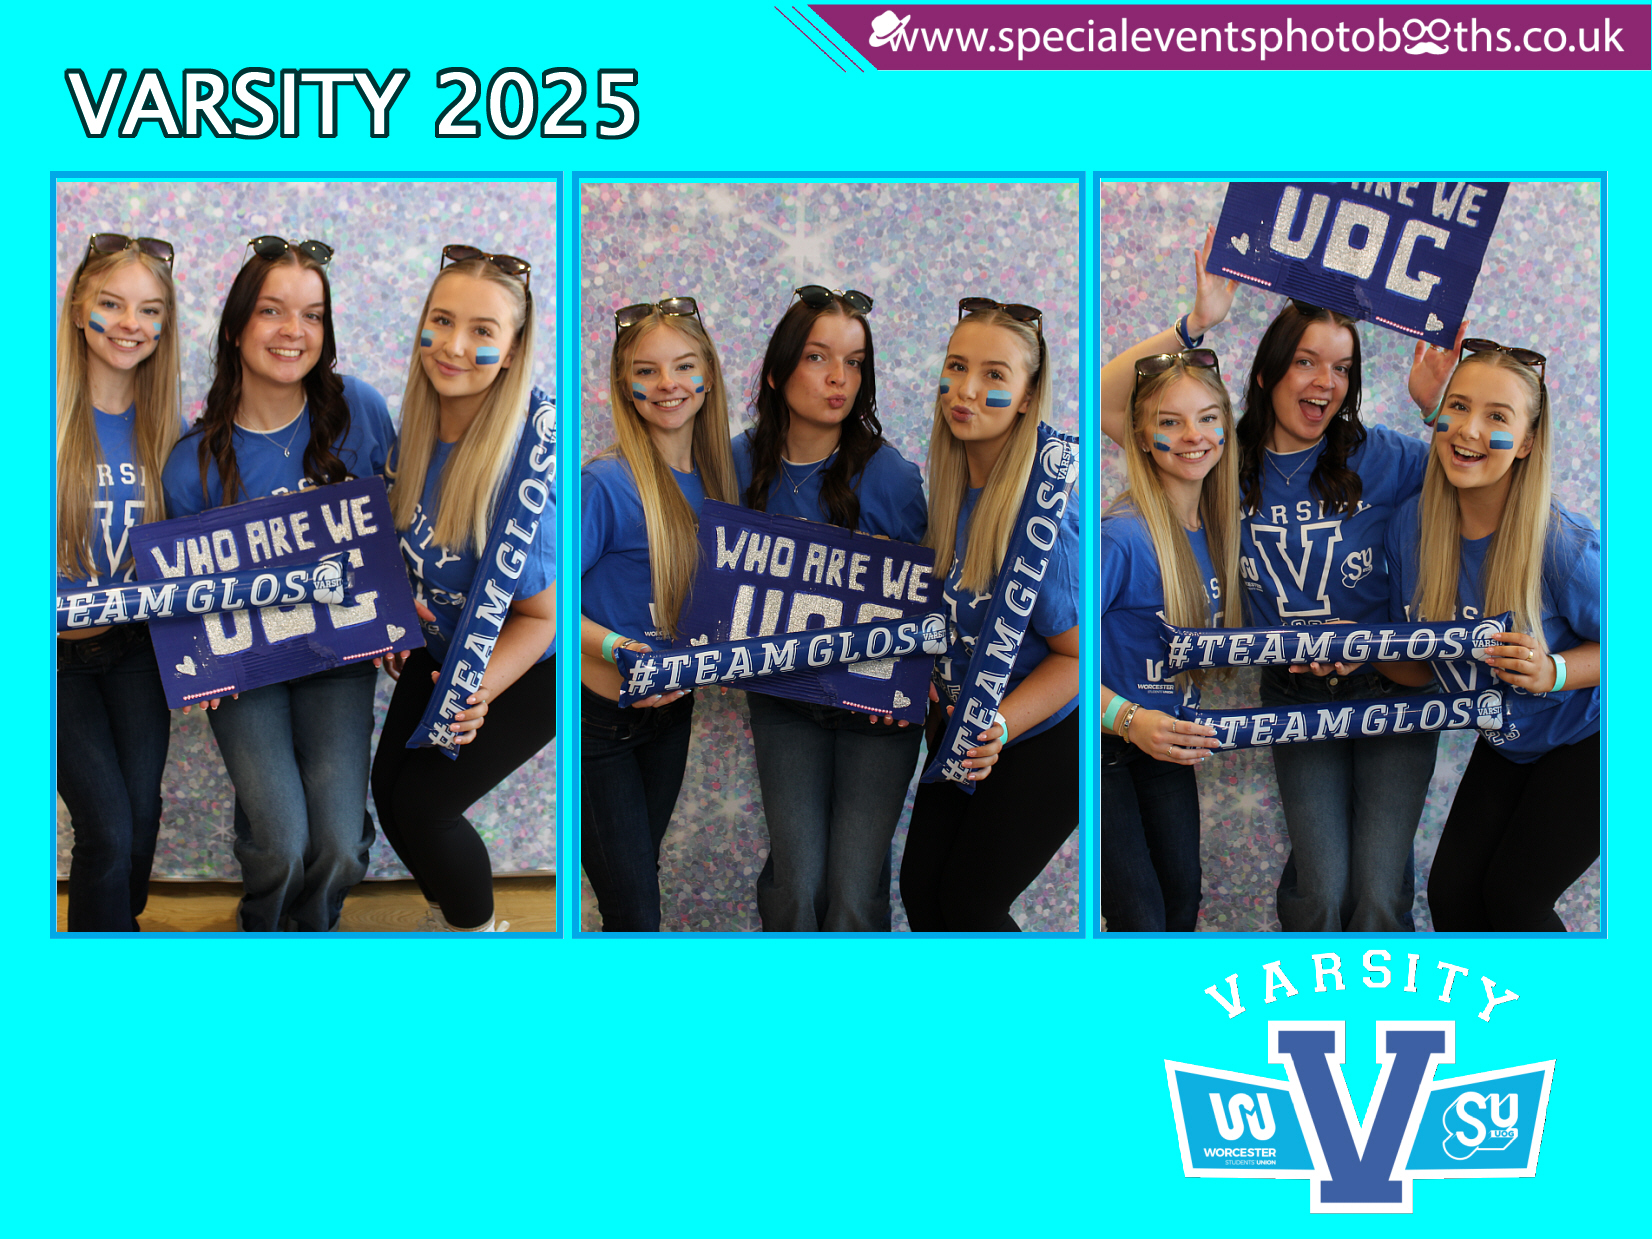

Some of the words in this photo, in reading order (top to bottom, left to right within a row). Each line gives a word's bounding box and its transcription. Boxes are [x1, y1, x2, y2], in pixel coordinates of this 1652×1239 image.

[1432, 182, 1488, 228] WE
[1270, 185, 1450, 301] UOG
[151, 529, 240, 578] WHO
[245, 511, 315, 563] ARE
[321, 495, 378, 543] WE
[715, 526, 796, 577] WHO
[803, 543, 871, 591] ARE
[883, 557, 933, 602] WE
[57, 570, 308, 628] EAMGLOS
[628, 622, 919, 696] #TEAMGLOS
[1168, 628, 1468, 669] #TEAMGLOS
